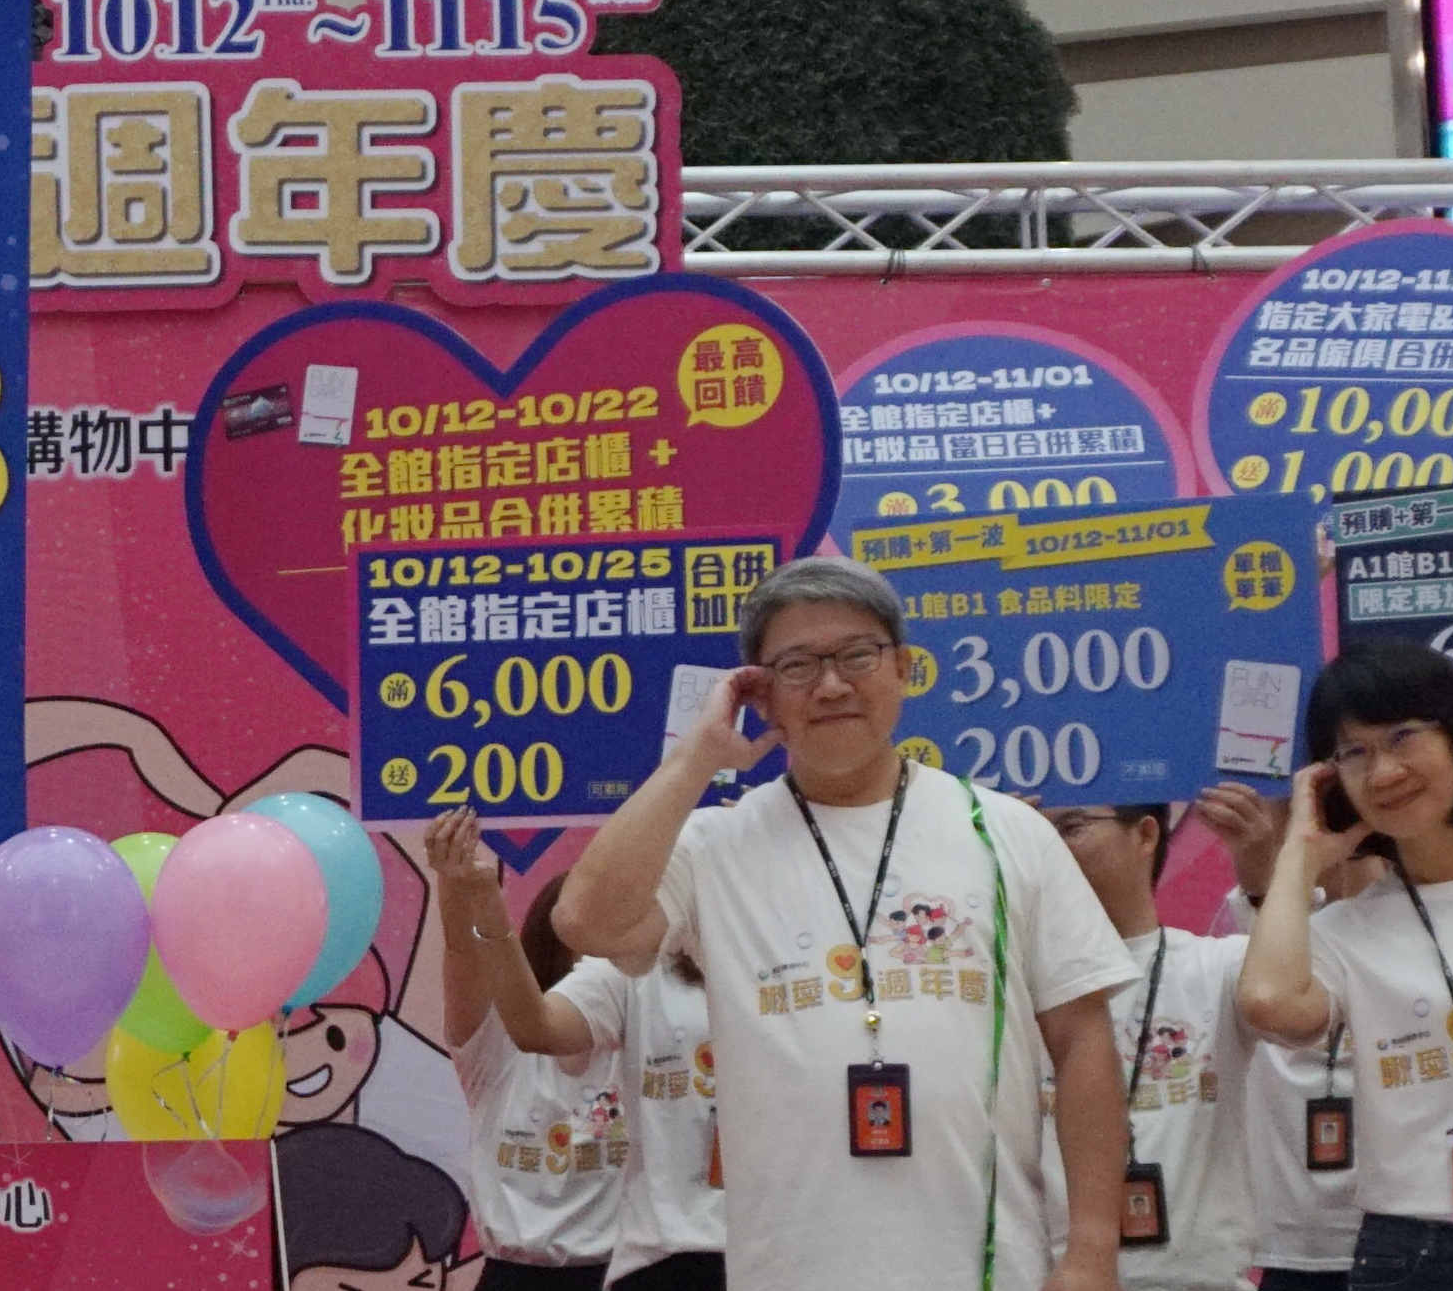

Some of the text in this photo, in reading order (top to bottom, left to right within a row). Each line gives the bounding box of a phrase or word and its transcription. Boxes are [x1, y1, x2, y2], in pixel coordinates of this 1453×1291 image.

[692, 338, 764, 370] 最高
[875, 366, 1092, 394] 10/12-11/01
[365, 387, 659, 438] 10/12-10/22
[1026, 519, 1190, 557] 10/12-11/01
[369, 549, 672, 588] 10/12-10/25
[368, 588, 676, 645] 全館指定店櫃
[426, 654, 632, 728] 6,000
[951, 626, 1169, 707] 3,000
[427, 742, 563, 804] 200
[955, 722, 1100, 787] 200
